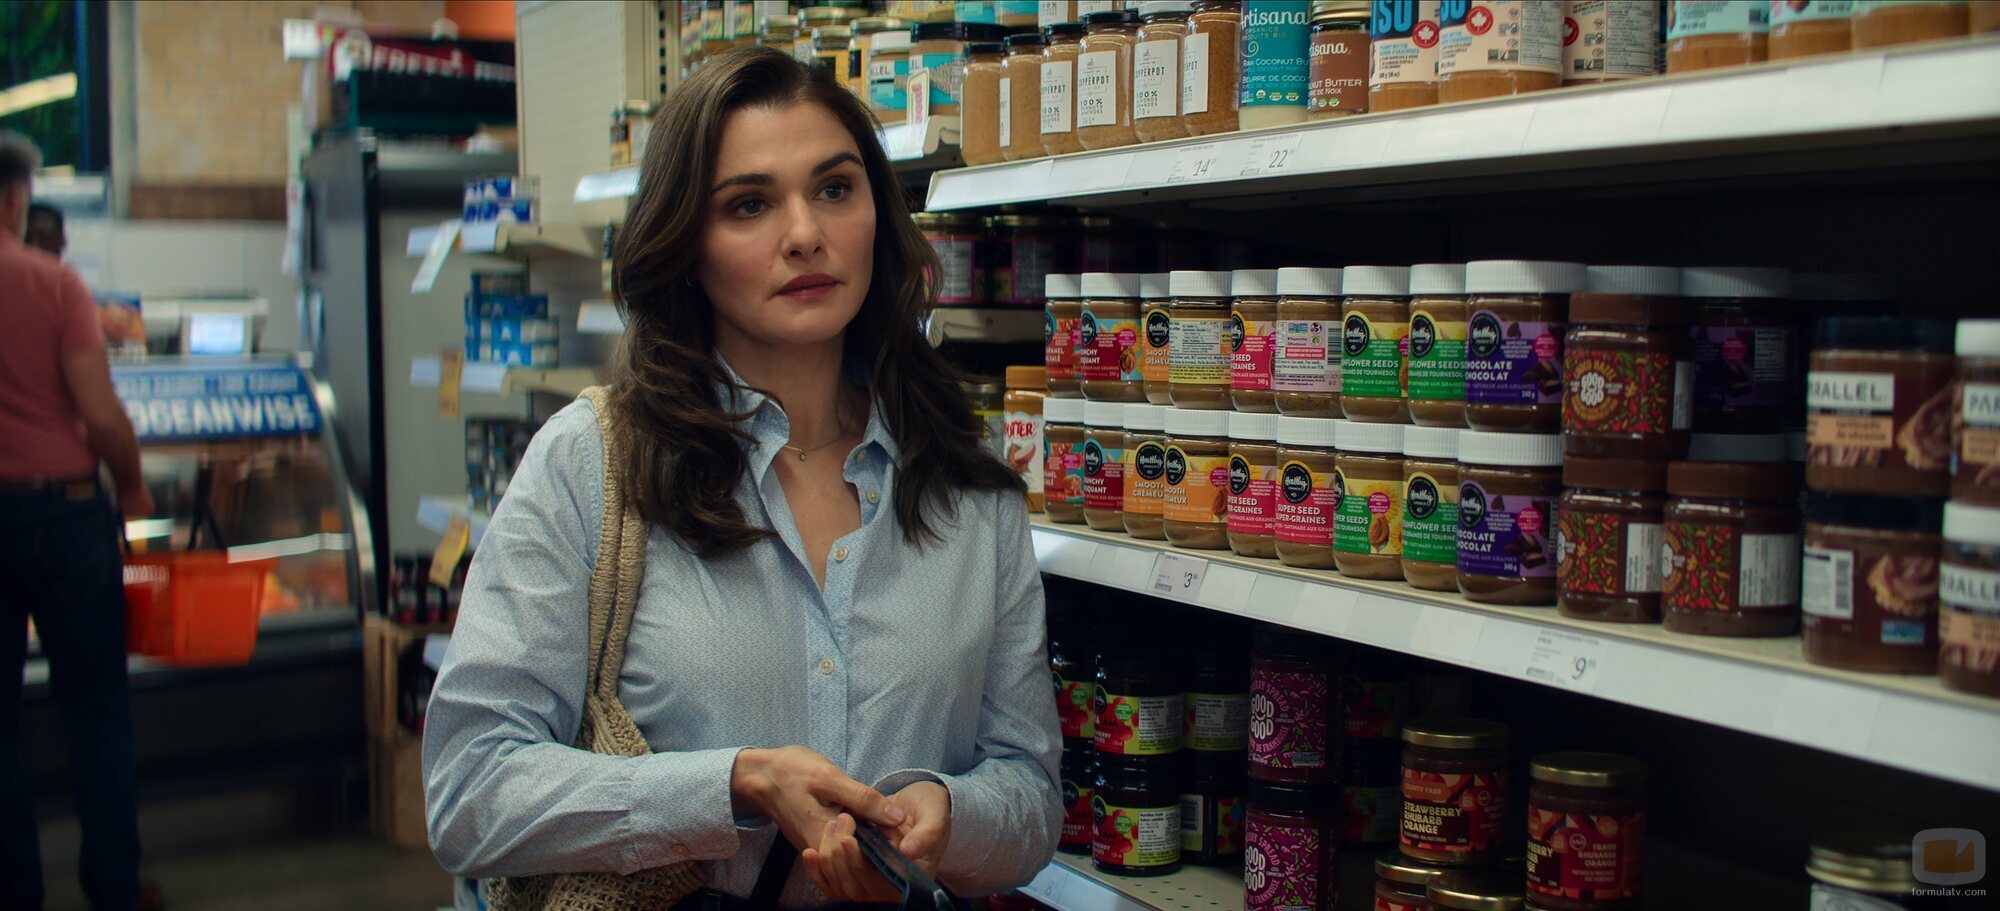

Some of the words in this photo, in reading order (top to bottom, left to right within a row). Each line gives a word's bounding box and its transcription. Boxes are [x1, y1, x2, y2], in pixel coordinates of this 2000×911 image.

[1325, 79, 1362, 87] BUTTER
[1372, 359, 1399, 368] SEEDS
[1363, 369, 1397, 377] TOURNESOL
[1808, 381, 1882, 402] RALLEL
[1239, 498, 1257, 506] SEED
[1296, 506, 1321, 515] SEED
[1347, 515, 1369, 525] SEEDS
[1441, 522, 1457, 532] SEE
[1404, 800, 1462, 817] STRAWBERRY
[1404, 810, 1443, 826] RHUBARB
[1404, 820, 1439, 835] ORANGE
